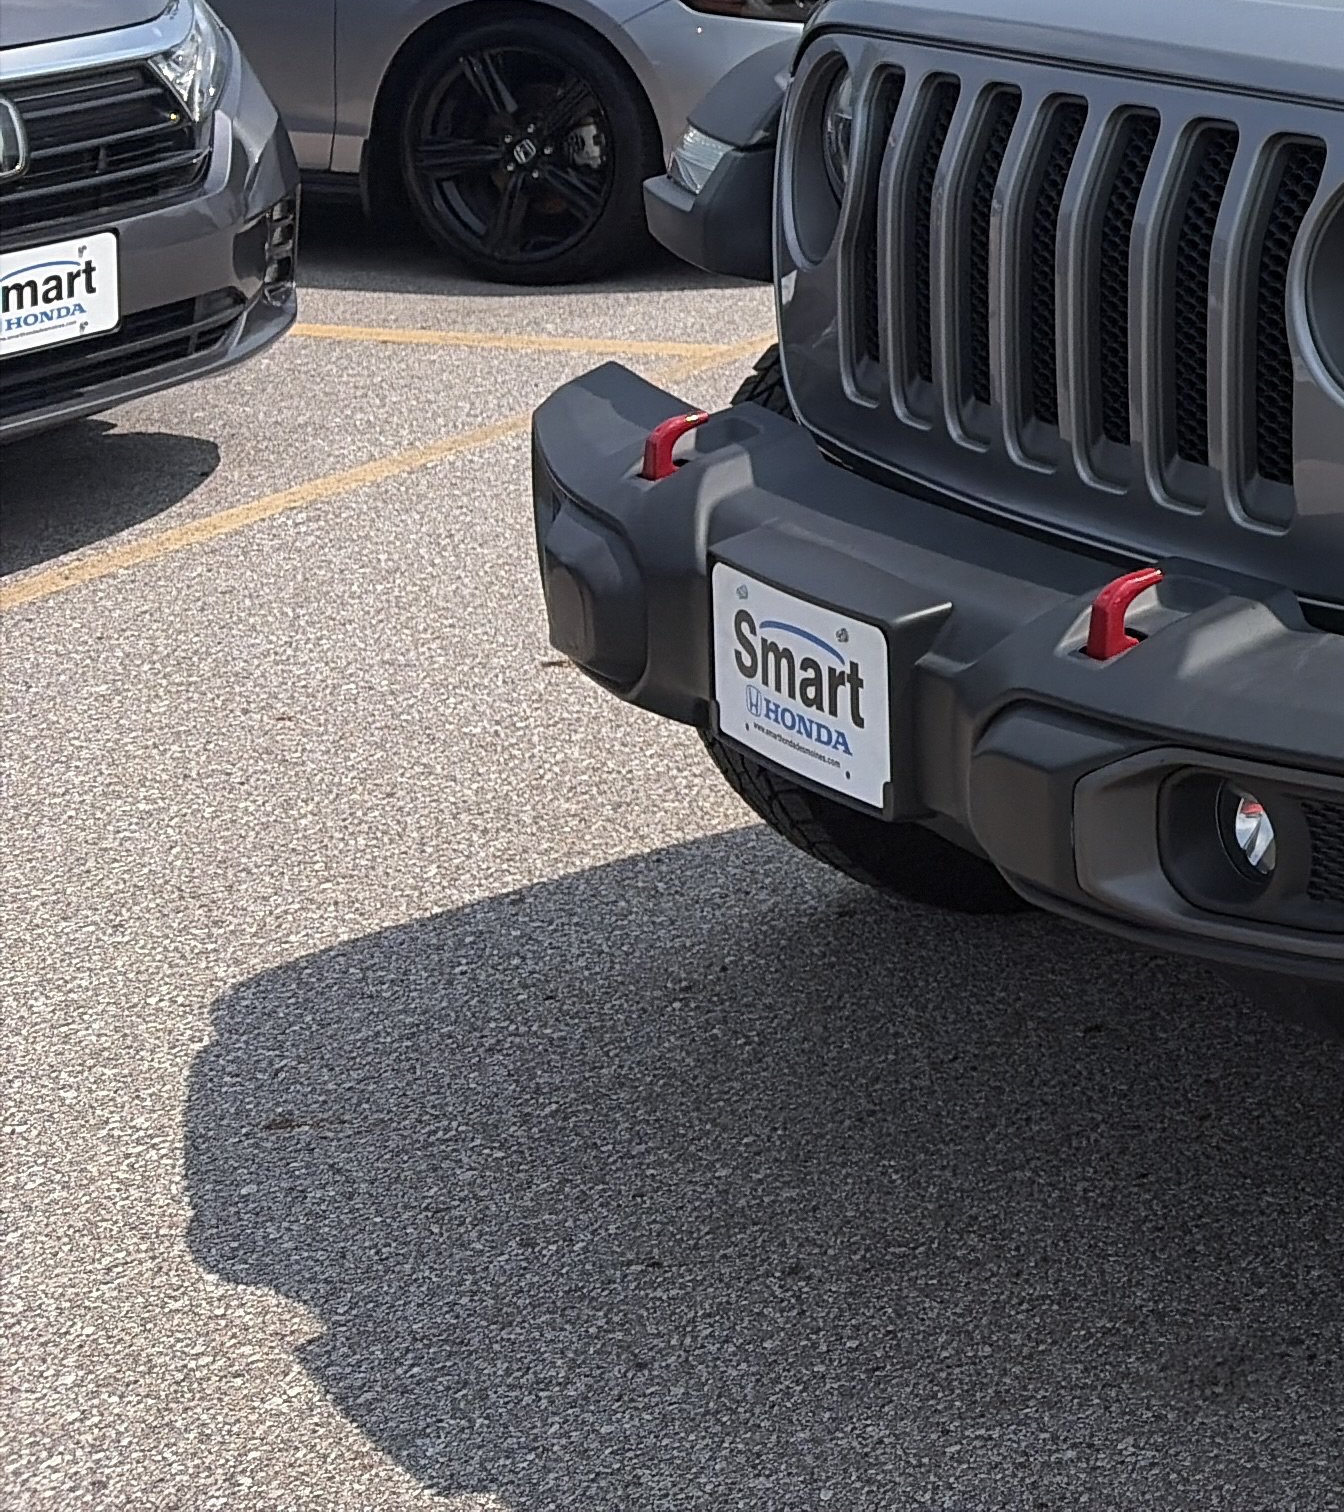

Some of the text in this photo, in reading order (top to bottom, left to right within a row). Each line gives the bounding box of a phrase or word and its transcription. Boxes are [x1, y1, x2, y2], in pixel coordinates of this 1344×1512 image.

[0, 260, 97, 314] mart
[5, 303, 87, 332] HONDA
[734, 609, 865, 729] Smart
[764, 698, 853, 756] HONDA
